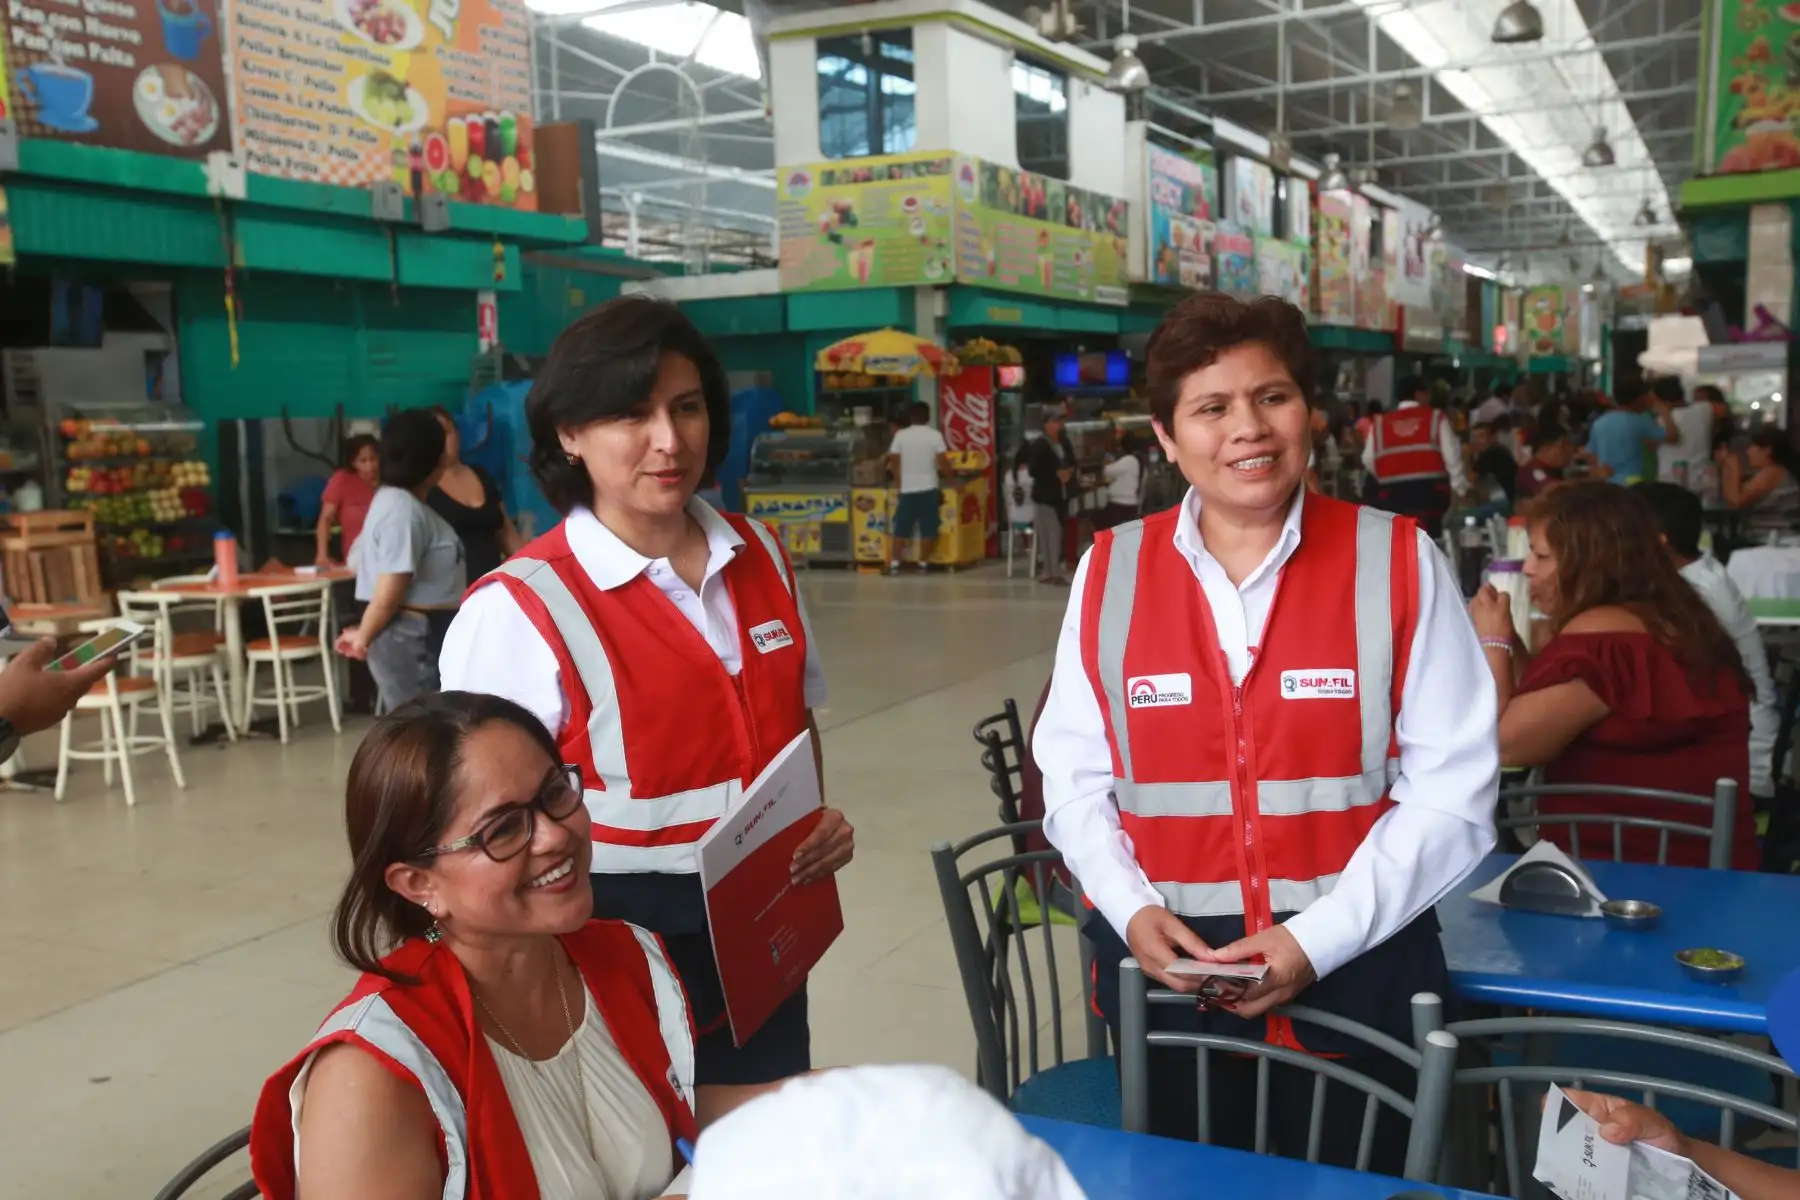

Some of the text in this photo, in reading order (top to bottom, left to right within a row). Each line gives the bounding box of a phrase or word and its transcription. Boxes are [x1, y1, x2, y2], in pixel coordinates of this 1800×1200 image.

[8, 0, 46, 24] Pan
[85, 15, 142, 45] Huevo
[11, 25, 49, 51] Pan
[88, 41, 136, 68] Palta
